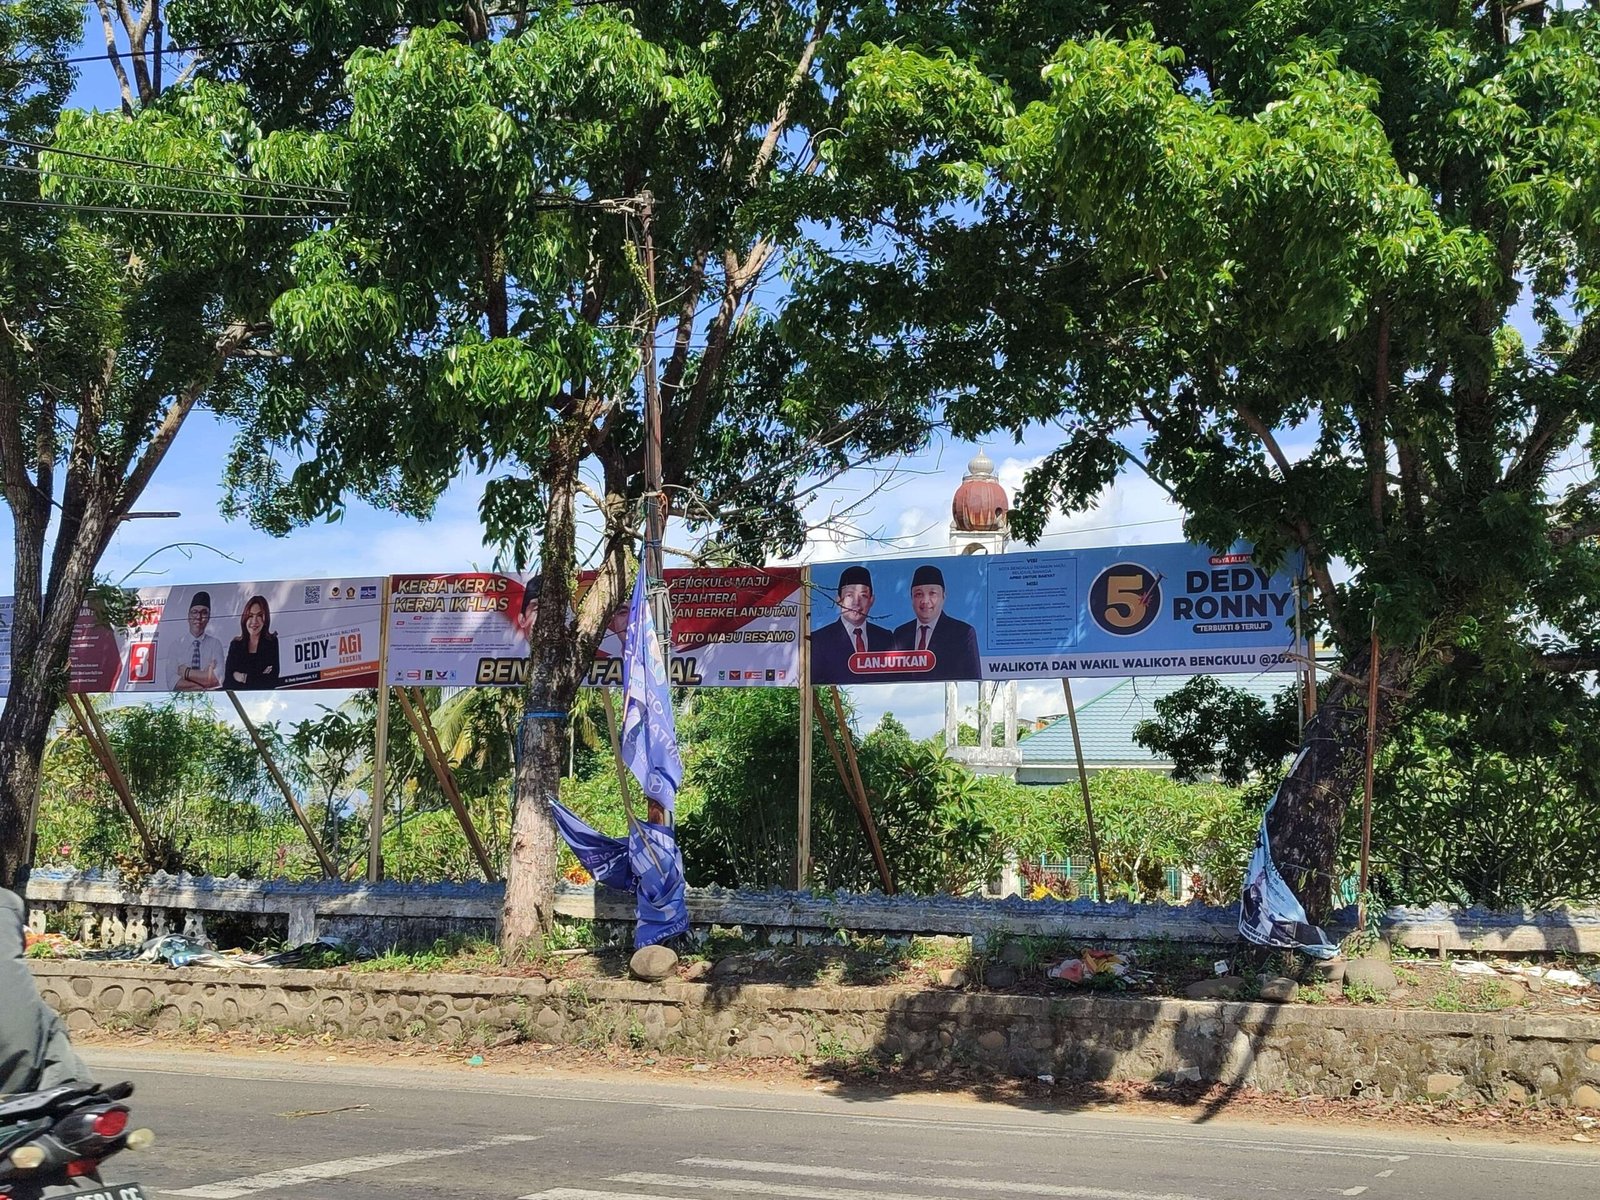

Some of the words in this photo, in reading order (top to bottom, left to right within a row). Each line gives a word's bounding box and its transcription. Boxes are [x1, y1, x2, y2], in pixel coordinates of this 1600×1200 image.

[397, 578, 448, 594] KERJA
[452, 578, 508, 594] KERAS
[735, 576, 770, 588] MAJU
[1187, 567, 1271, 593] DEDY
[394, 597, 445, 612] KERJA
[449, 597, 509, 612] IKHLAS
[671, 592, 737, 603] SEJAHTERA
[1104, 574, 1145, 627] 5
[695, 605, 798, 618] BERKELANJUTAN
[1173, 592, 1291, 620] RONNY
[1234, 623, 1240, 631] &
[677, 633, 705, 643] KITO
[707, 632, 742, 643] MAJU
[743, 630, 796, 643] BESAMO
[294, 639, 329, 663] DEDY
[339, 633, 362, 656] AGI
[134, 646, 149, 677] 3
[304, 661, 320, 670] BLACK
[856, 655, 928, 669] LANJUTKAN
[988, 661, 1049, 673] WALIKOTA
[1051, 660, 1077, 671] DAN
[1080, 658, 1119, 670] WAKIL
[1122, 656, 1185, 669] WALIKOTA
[1187, 654, 1256, 667] BENGKULU
